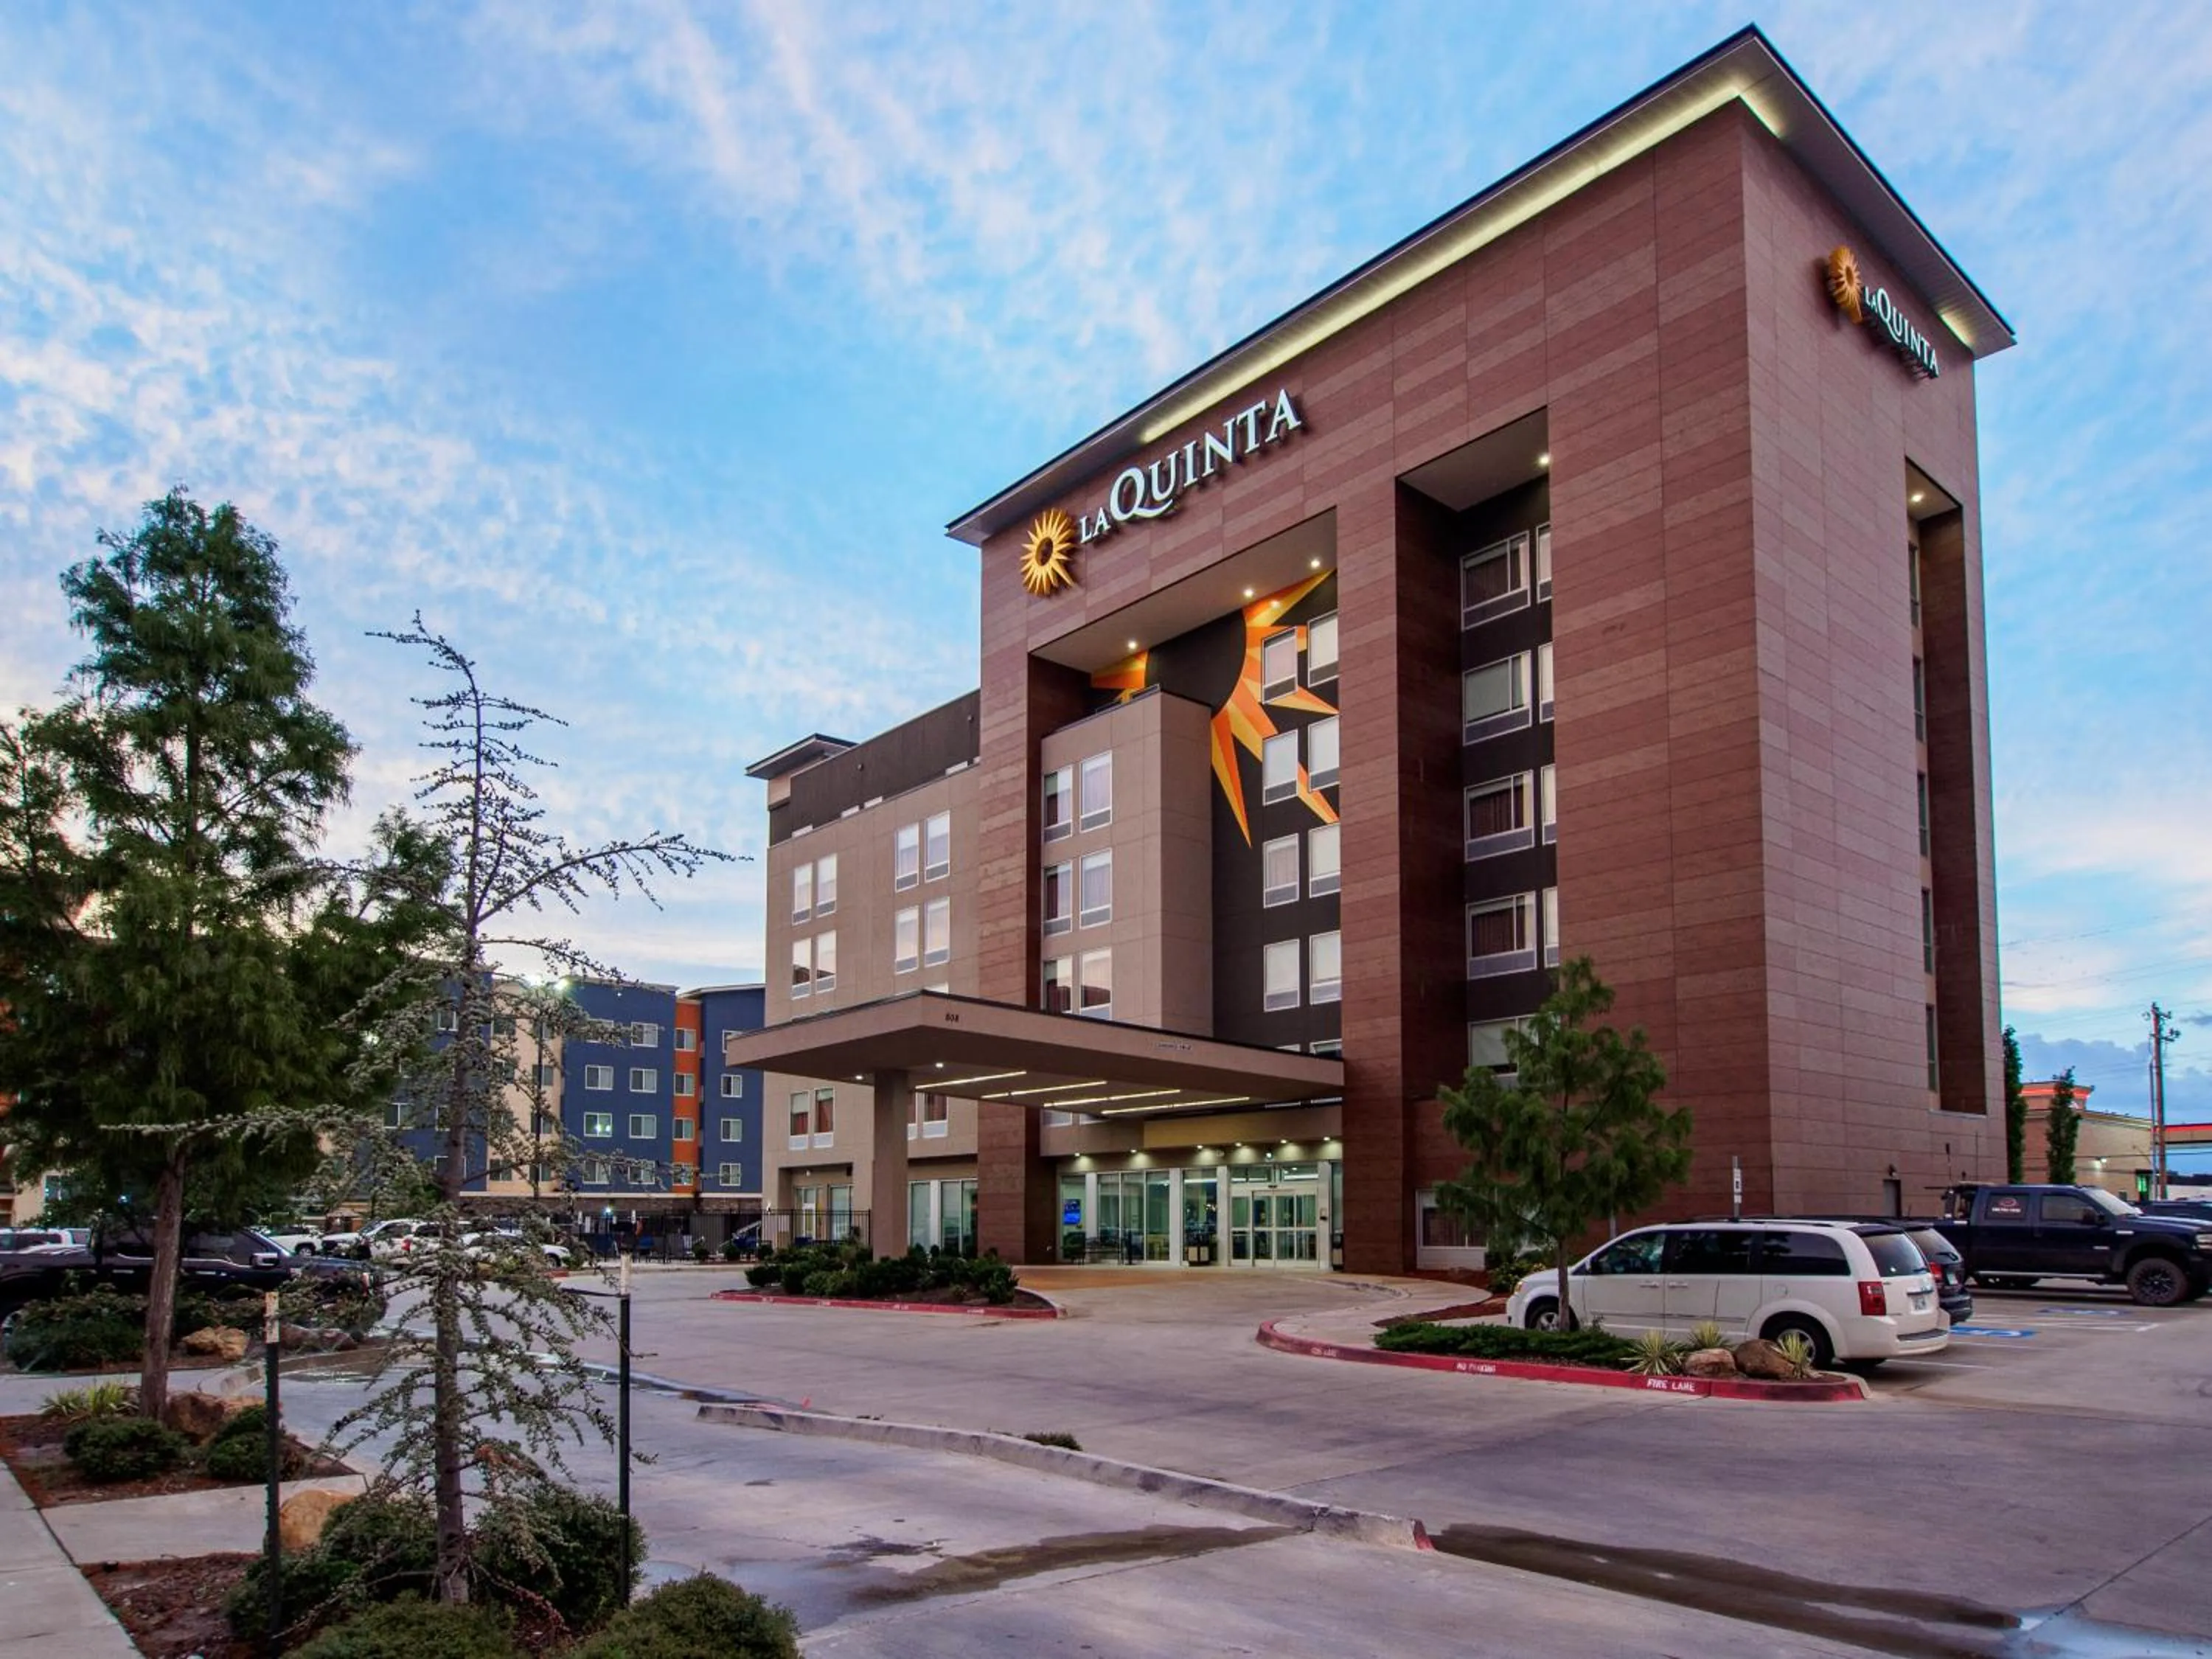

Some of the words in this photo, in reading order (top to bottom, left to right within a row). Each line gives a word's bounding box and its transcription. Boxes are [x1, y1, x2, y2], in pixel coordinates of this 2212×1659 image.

[1865, 285, 1878, 313] LA
[1877, 288, 1939, 378] QUINTA
[1079, 507, 1111, 544] LA
[1110, 389, 1302, 522] QUINTA
[1646, 1378, 1668, 1389] FIRE
[1672, 1381, 1696, 1392] LANE
